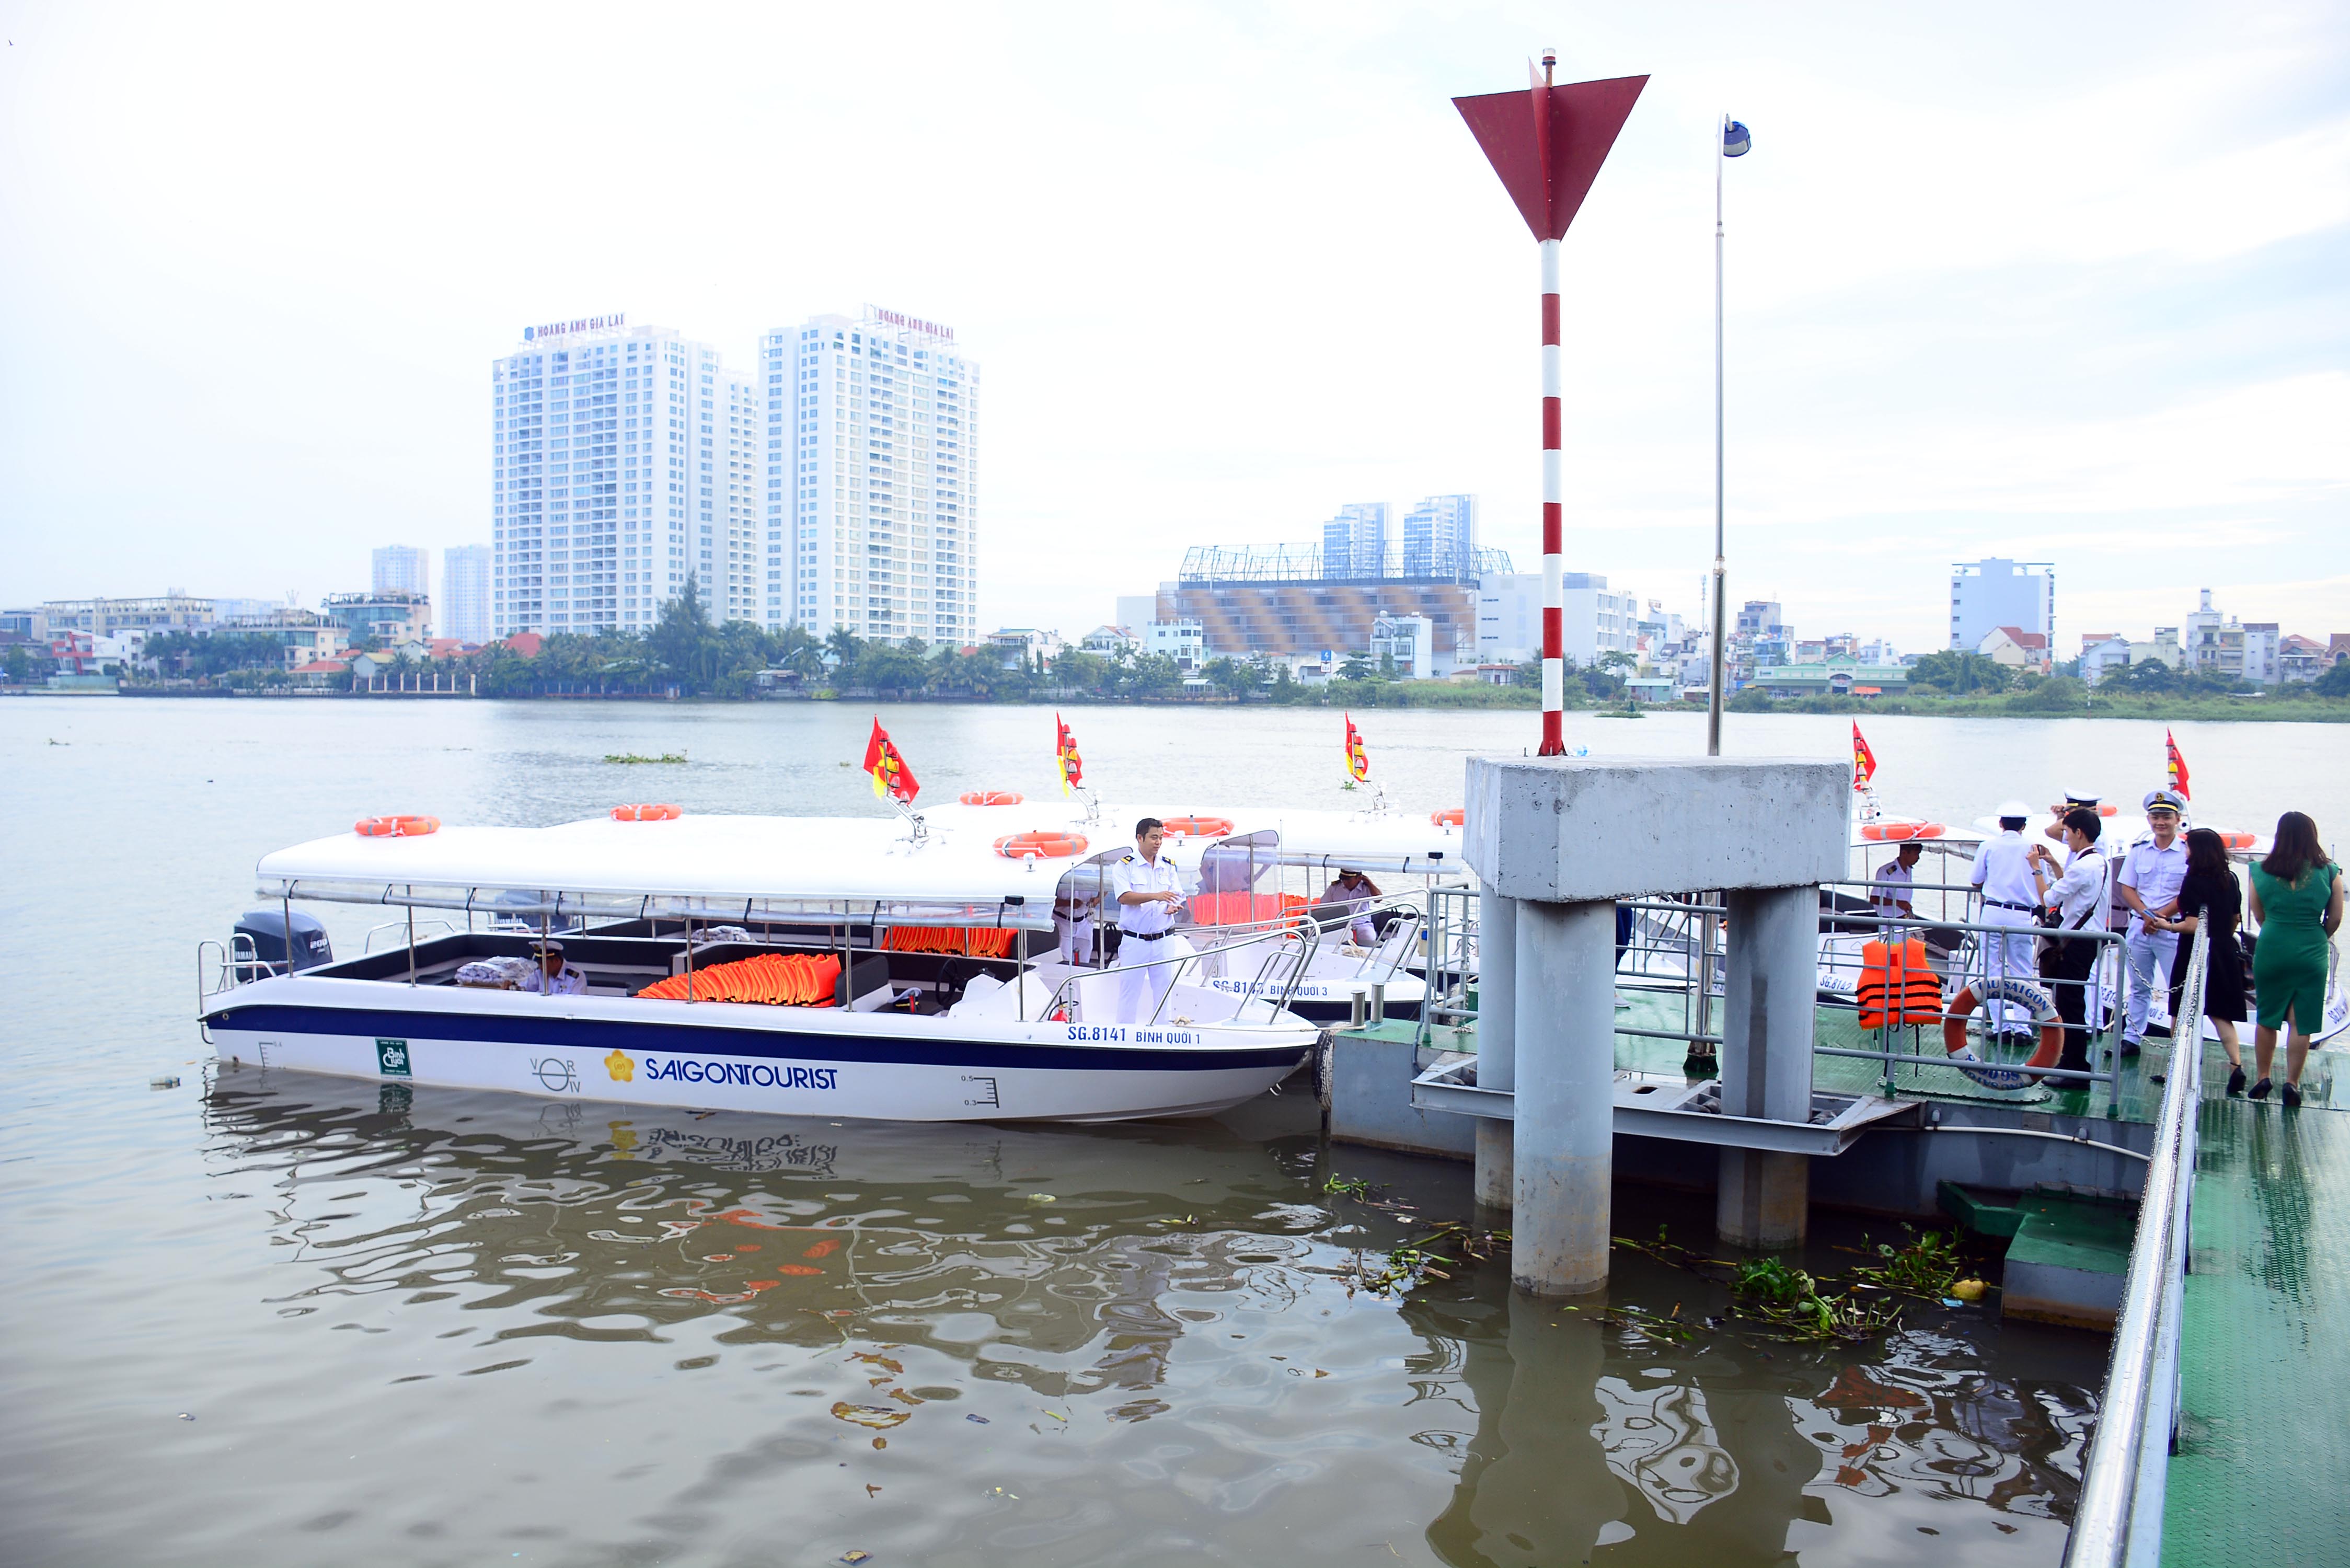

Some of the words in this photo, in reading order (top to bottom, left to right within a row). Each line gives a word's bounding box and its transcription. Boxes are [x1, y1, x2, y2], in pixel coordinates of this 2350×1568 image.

[608, 314, 623, 327] LAI
[310, 939, 328, 949] 200
[1322, 987, 1328, 996] 3
[1068, 1026, 1125, 1041] SG.8141
[1195, 1034, 1200, 1044] 1
[530, 1058, 537, 1069] V
[566, 1060, 575, 1071] R
[646, 1058, 837, 1089] SAIGONTOURIST
[570, 1081, 580, 1092] IV
